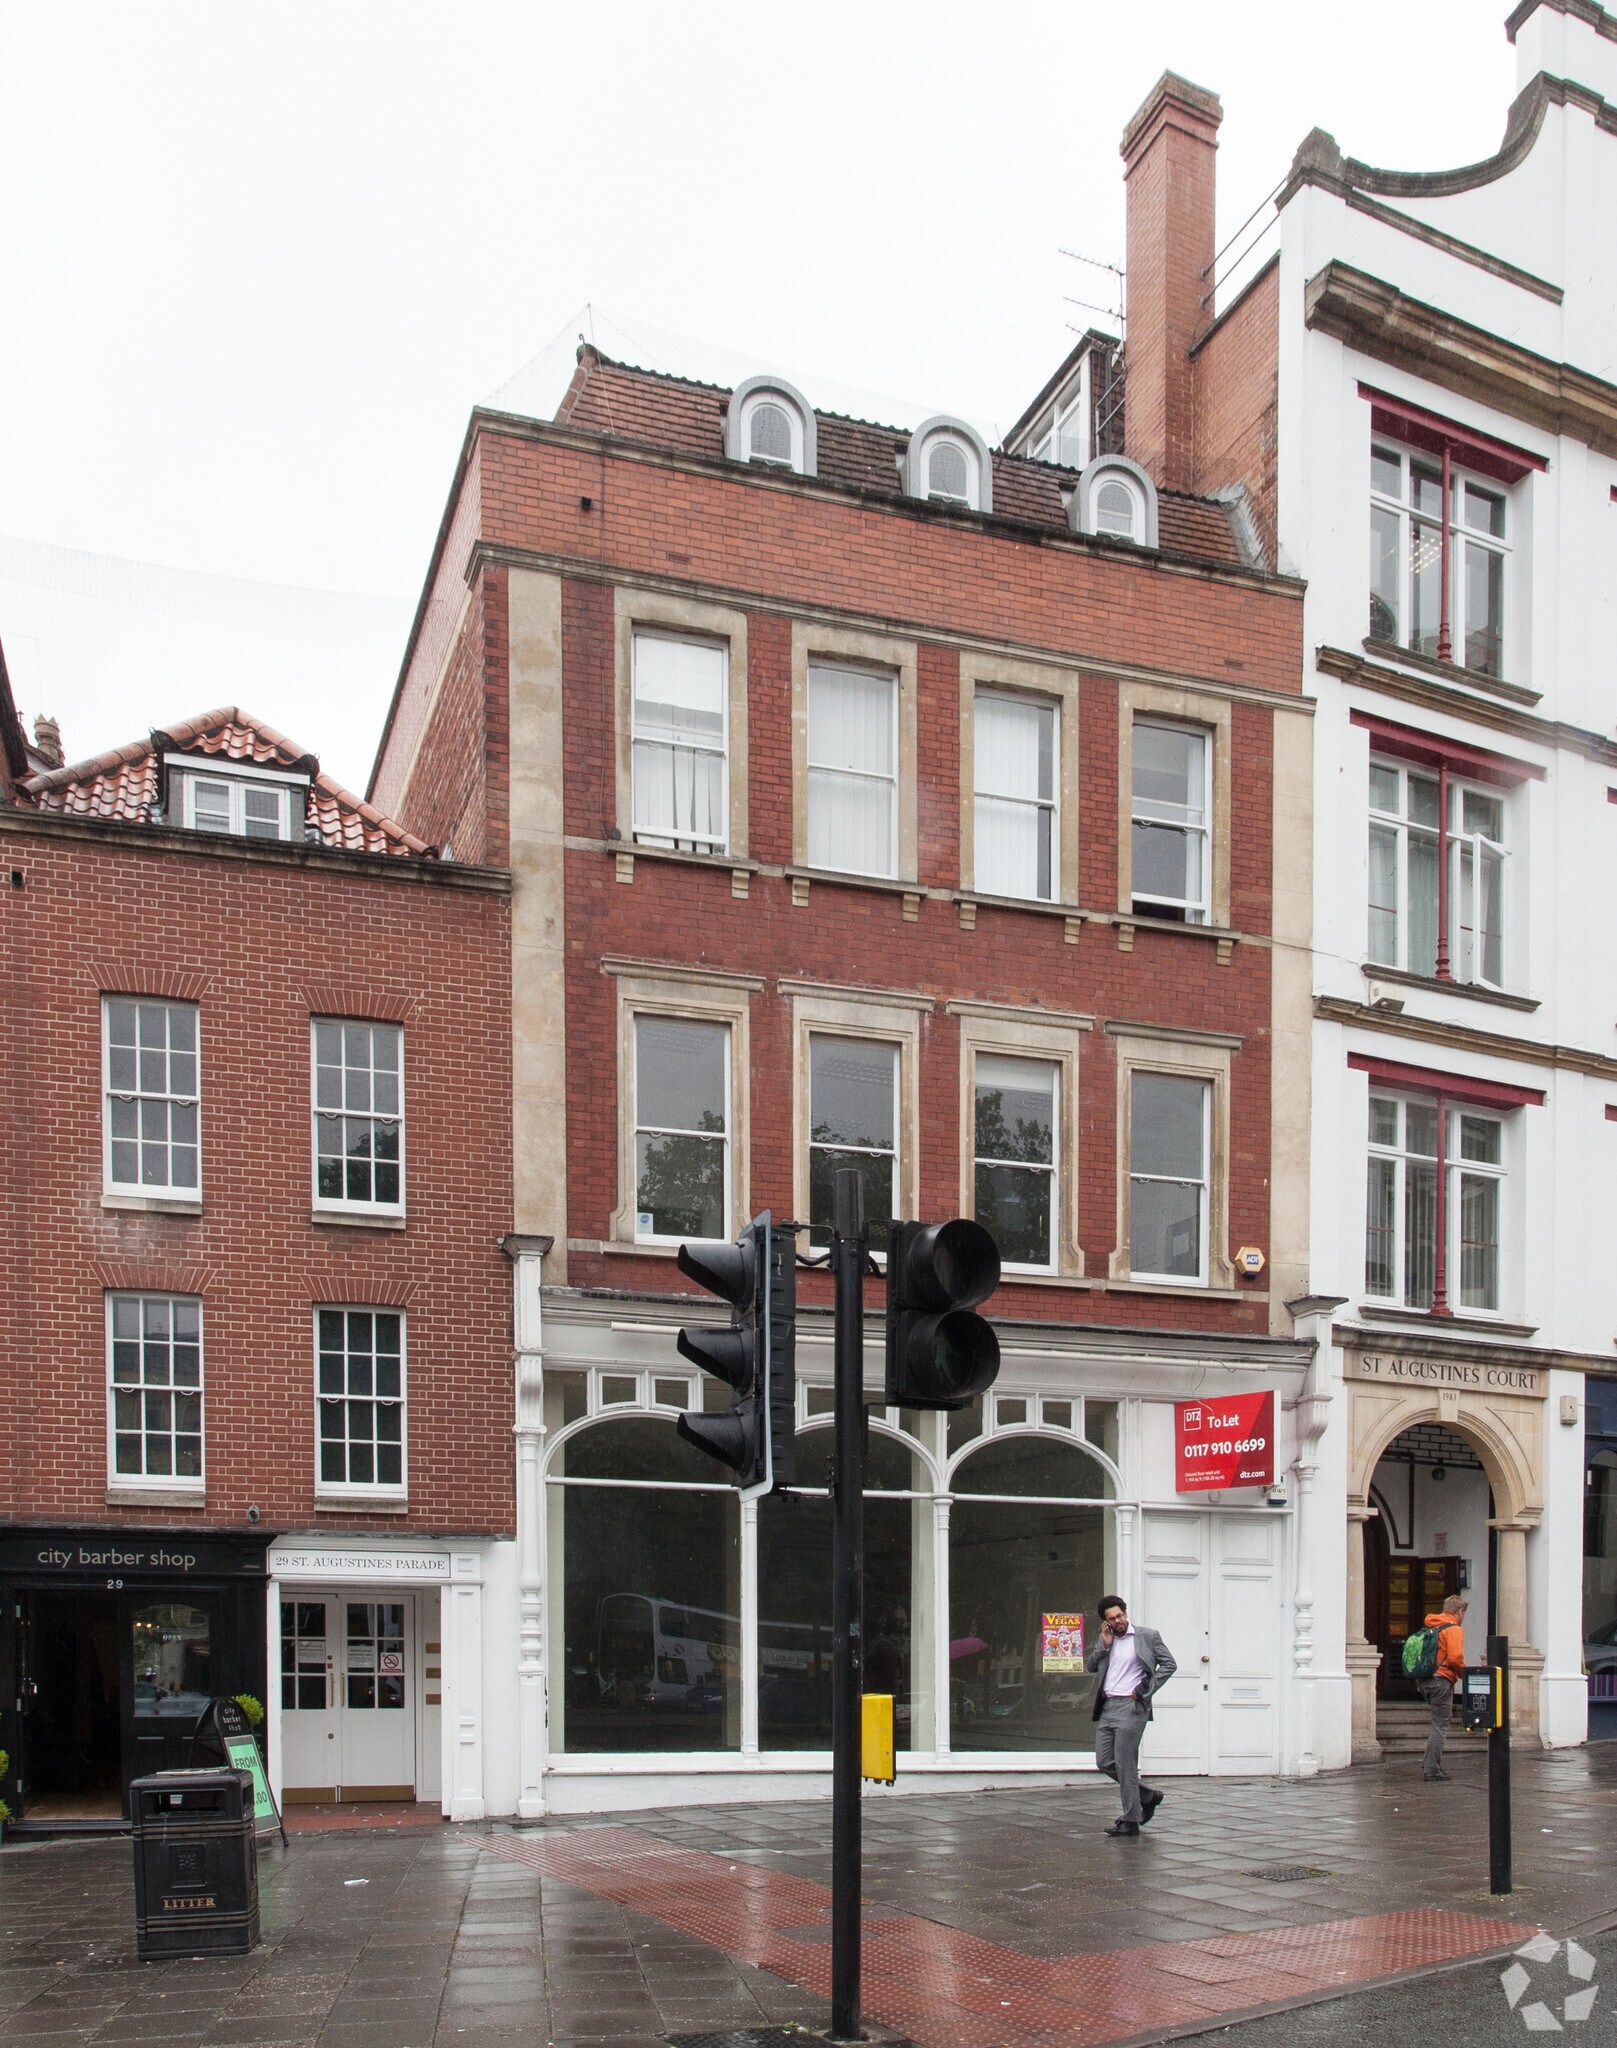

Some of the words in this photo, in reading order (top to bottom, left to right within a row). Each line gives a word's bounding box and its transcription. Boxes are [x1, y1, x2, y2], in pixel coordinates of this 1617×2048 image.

[1362, 1357, 1382, 1373] ST
[1388, 1359, 1480, 1384] AUGUSTINES
[1487, 1370, 1537, 1389] COURT
[1186, 1411, 1201, 1422] DTZ
[1207, 1416, 1221, 1428] To
[1223, 1414, 1240, 1427] Let
[1184, 1444, 1209, 1458] 0117
[1211, 1441, 1232, 1455] 910
[1234, 1438, 1266, 1453] 6699
[1240, 1471, 1265, 1479] dtz.com
[37, 1548, 72, 1568] city
[79, 1547, 145, 1565] barber
[150, 1550, 196, 1571] shop
[275, 1556, 289, 1566] 29
[291, 1557, 309, 1567] ST.
[313, 1557, 393, 1569] AUGUSTINES
[396, 1559, 446, 1570] PARADE
[107, 1579, 124, 1589] 29
[222, 1716, 241, 1724] barber
[234, 1756, 258, 1769] FROM
[163, 1897, 215, 1908] LITTER
